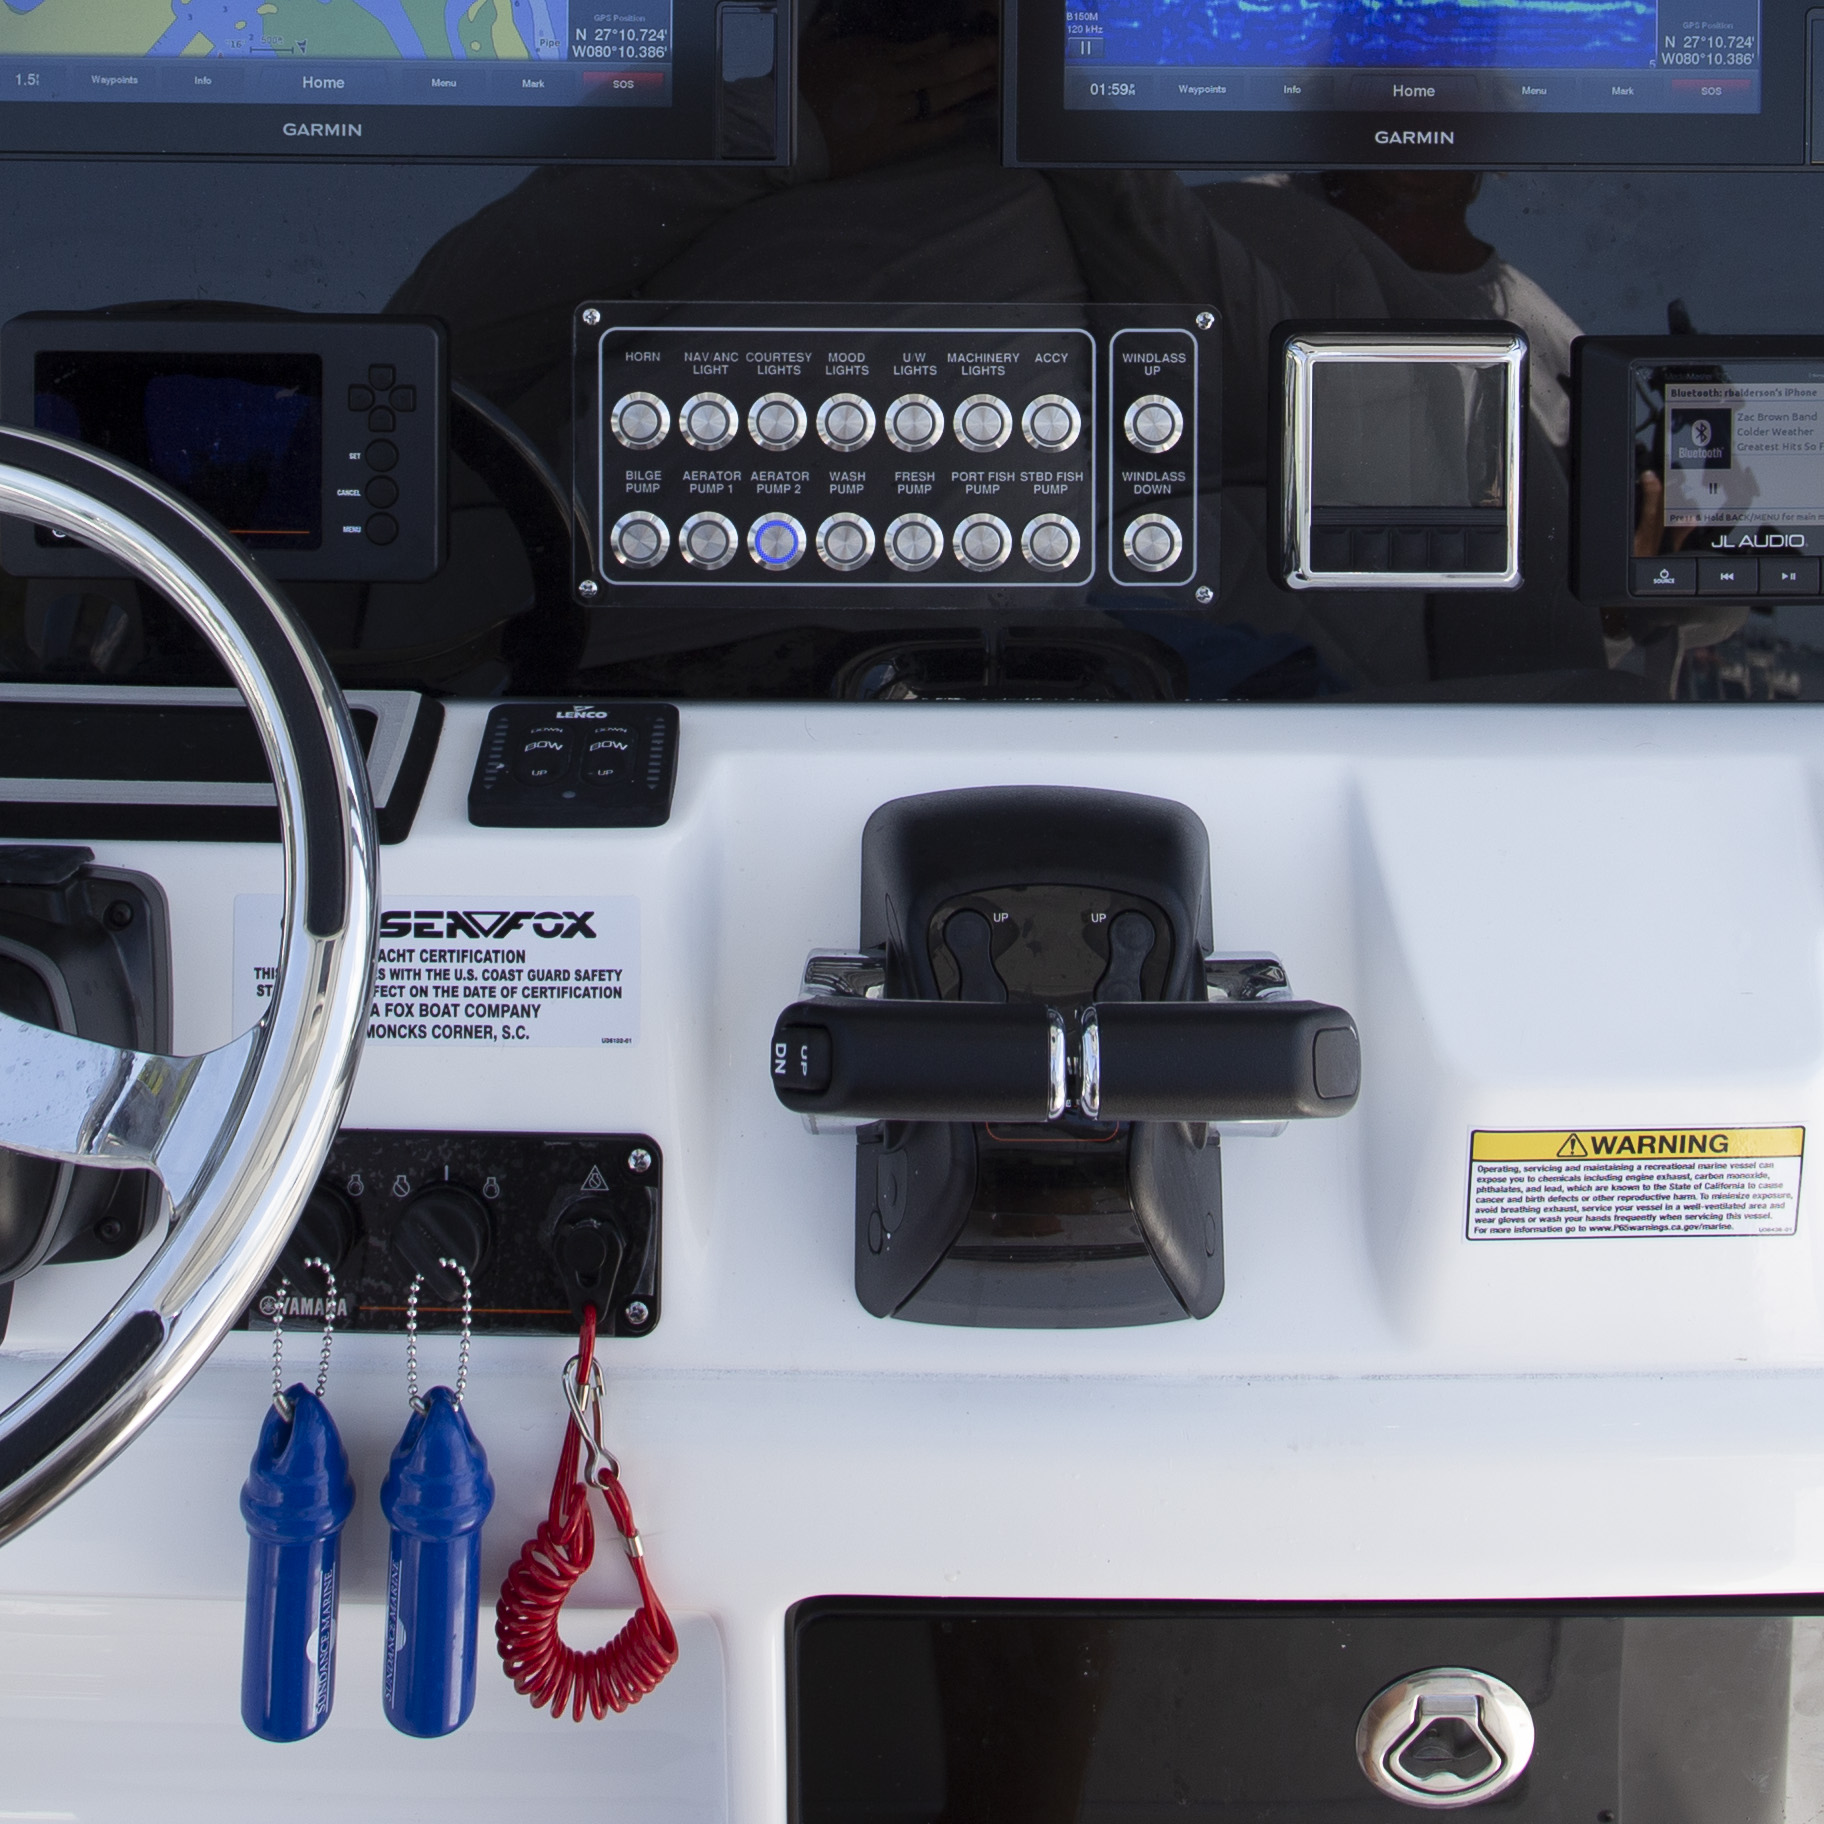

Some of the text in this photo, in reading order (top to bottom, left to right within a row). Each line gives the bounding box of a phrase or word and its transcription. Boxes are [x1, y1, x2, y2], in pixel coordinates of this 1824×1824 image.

[576, 28, 587, 41] N
[1665, 35, 1676, 48] N
[91, 75, 634, 90] Waypoints Info Home Menu Mark SOS
[1178, 85, 1722, 98] Waypoints Info Home Menu Mark SOS
[282, 122, 362, 137] GARMIN
[1375, 131, 1455, 145] GARMIN
[625, 351, 661, 362] HORN
[684, 352, 739, 363] NAV/ANC
[745, 352, 813, 363] COURTESY
[828, 352, 866, 363] MOOD
[902, 353, 927, 363] U/W
[947, 353, 1020, 364] MACHINERY
[1034, 353, 1068, 364] ACCY
[1122, 353, 1187, 364] WINDLASS
[693, 365, 729, 375] LIGHT
[757, 365, 802, 376] LIGHTS
[825, 365, 870, 376] LIGHTS
[893, 365, 937, 376] LIGHTS
[961, 366, 1006, 376] LIGHTS
[1144, 366, 1161, 376] UP
[1737, 412, 1818, 422] Zac Brown Band
[1737, 427, 1814, 437] Colder Weather
[1678, 447, 1722, 459] Bluetooth
[626, 470, 662, 481] BILGE
[682, 470, 742, 481] AERATOR
[750, 471, 810, 482] AERATOR
[829, 471, 866, 482] WASH
[895, 471, 935, 482] FRESH
[951, 471, 1015, 482] PORT FISH
[1020, 471, 1084, 482] STBD FISH
[1121, 471, 1186, 482] WINDLASS
[626, 483, 660, 494] PUMP
[689, 483, 733, 494] PUMP 1
[756, 484, 802, 494] PUMP 2
[829, 484, 864, 495] PUMP
[897, 484, 933, 495] PUMP
[965, 484, 1000, 495] PUMP
[1033, 484, 1069, 495] PUMP
[1134, 484, 1172, 495] DOWN
[1711, 534, 1805, 548] JL AUDIO
[556, 711, 608, 719] LENCO
[524, 740, 563, 752] BOW
[589, 740, 628, 752] BOW
[993, 912, 1009, 923] UP
[1091, 912, 1107, 923] UP
[377, 949, 526, 964] ACHT CERTIFICATION
[389, 968, 421, 980] WITH
[425, 968, 450, 981] THE
[454, 969, 478, 981] U.S.
[482, 969, 523, 981] COAST
[527, 969, 570, 981] GUARD
[574, 969, 623, 982] SAFETY
[409, 985, 428, 997] ON
[433, 985, 459, 998] THE
[463, 986, 496, 998] DATE
[500, 986, 517, 998] OF
[521, 986, 622, 999] CERTIFICATION
[385, 1003, 414, 1017] FOX
[419, 1003, 460, 1018] BOAT
[464, 1004, 541, 1018] COMPANY
[432, 1024, 497, 1042] CORNER,
[501, 1025, 530, 1040] S.C.
[775, 1043, 787, 1074] DN
[800, 1045, 808, 1076] UP
[1591, 1134, 1729, 1155] WARNING
[316, 1568, 333, 1714] SUNDANCE MARINE
